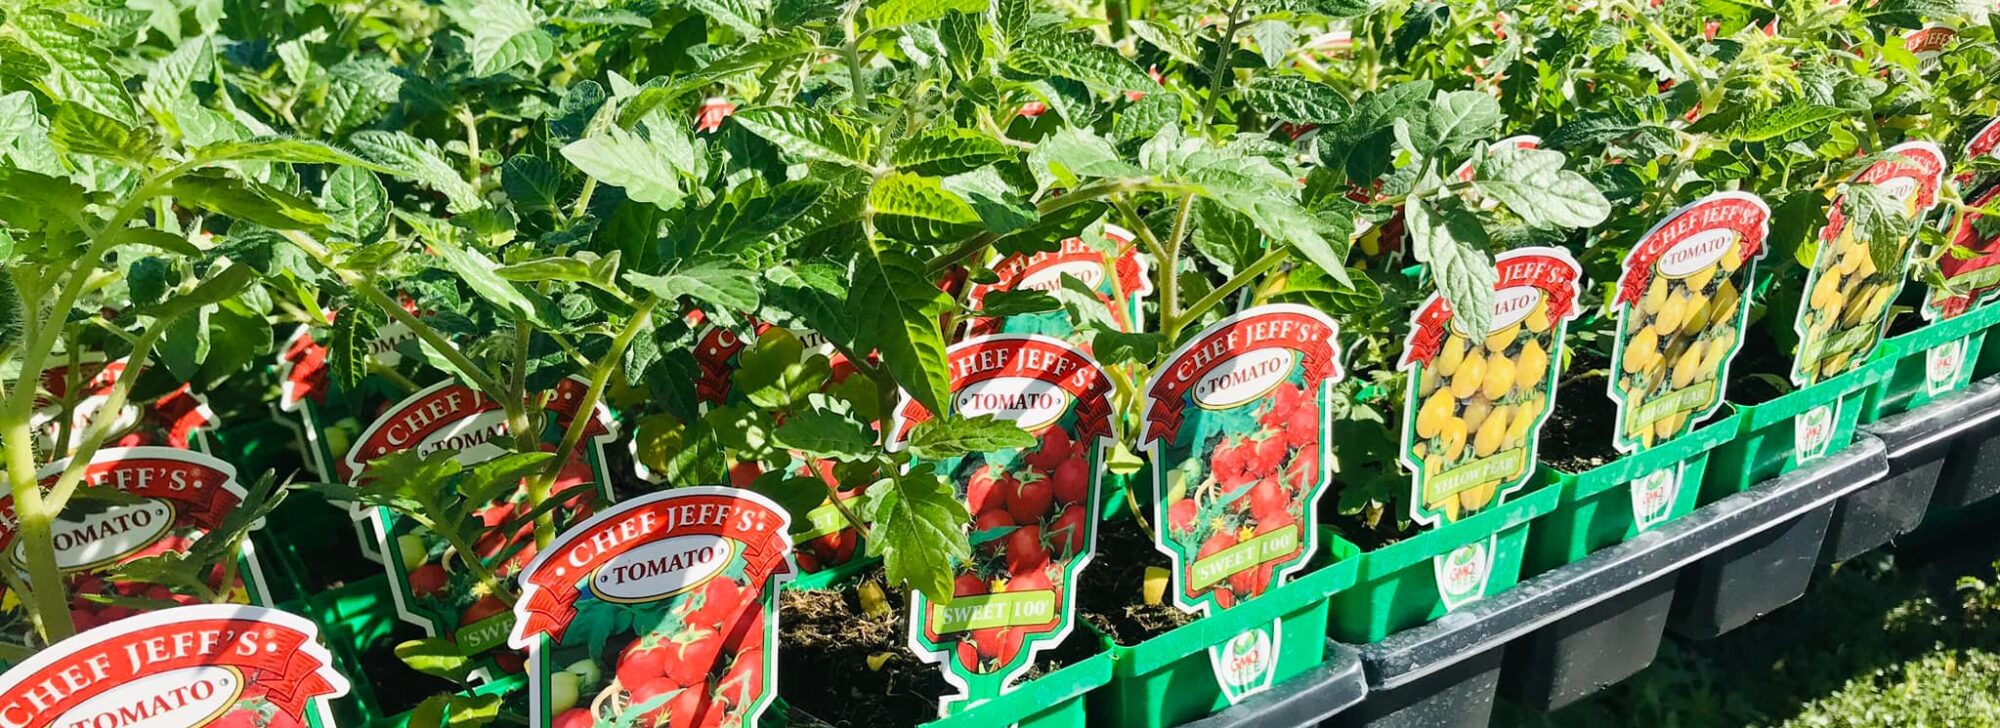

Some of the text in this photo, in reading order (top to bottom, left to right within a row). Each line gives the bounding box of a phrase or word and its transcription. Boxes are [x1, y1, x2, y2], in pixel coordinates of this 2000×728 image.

[1924, 32, 1948, 46] JEFF
[1648, 205, 1752, 255] CHEF JEFF'S
[1669, 236, 1725, 266] TOMATO
[1504, 262, 1561, 285] JEFF'S
[1494, 295, 1530, 316] ATO
[1016, 348, 1088, 388] JEFF'S
[1177, 320, 1311, 382] CHEF JEFF'S
[1208, 357, 1281, 393] TOMATO
[386, 391, 463, 447] CHEF
[972, 393, 1053, 410] TOMATO
[431, 422, 510, 452] TOMAT
[88, 467, 188, 491] EFF'S
[1435, 458, 1514, 494] YELLOW PEAR
[53, 509, 152, 552] OMATO
[568, 504, 756, 568] CHEF JEFF'S
[612, 546, 715, 585] TOMATO
[463, 619, 514, 648] 'SWE
[0, 629, 260, 728] CHEF JEFF'S
[1231, 649, 1259, 673] GMO
